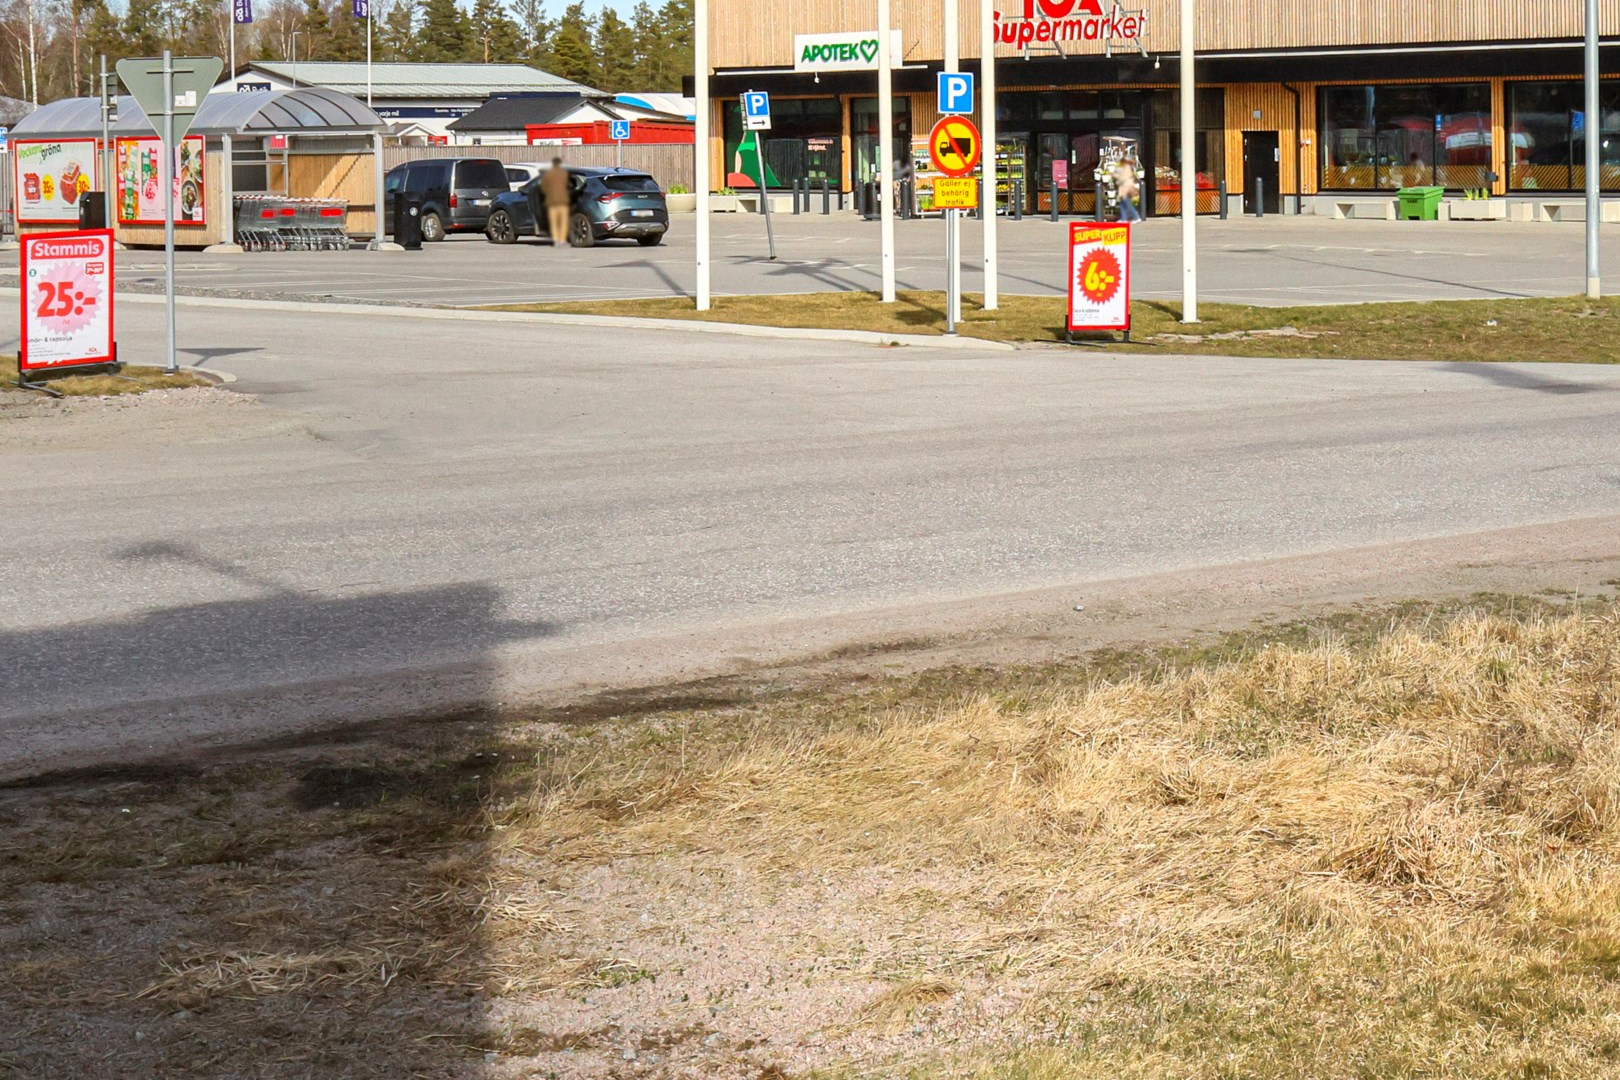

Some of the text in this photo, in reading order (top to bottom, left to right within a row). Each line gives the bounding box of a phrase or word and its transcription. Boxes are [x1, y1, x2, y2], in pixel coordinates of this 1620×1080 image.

[801, 42, 859, 62] APOTEK
[948, 77, 967, 109] P
[751, 95, 764, 114] P
[41, 144, 61, 160] gröna
[1074, 229, 1126, 242] SUPER KLIPP
[35, 241, 100, 257] Stammis
[1085, 262, 1114, 291] 6:-
[37, 281, 96, 317] 25:-
